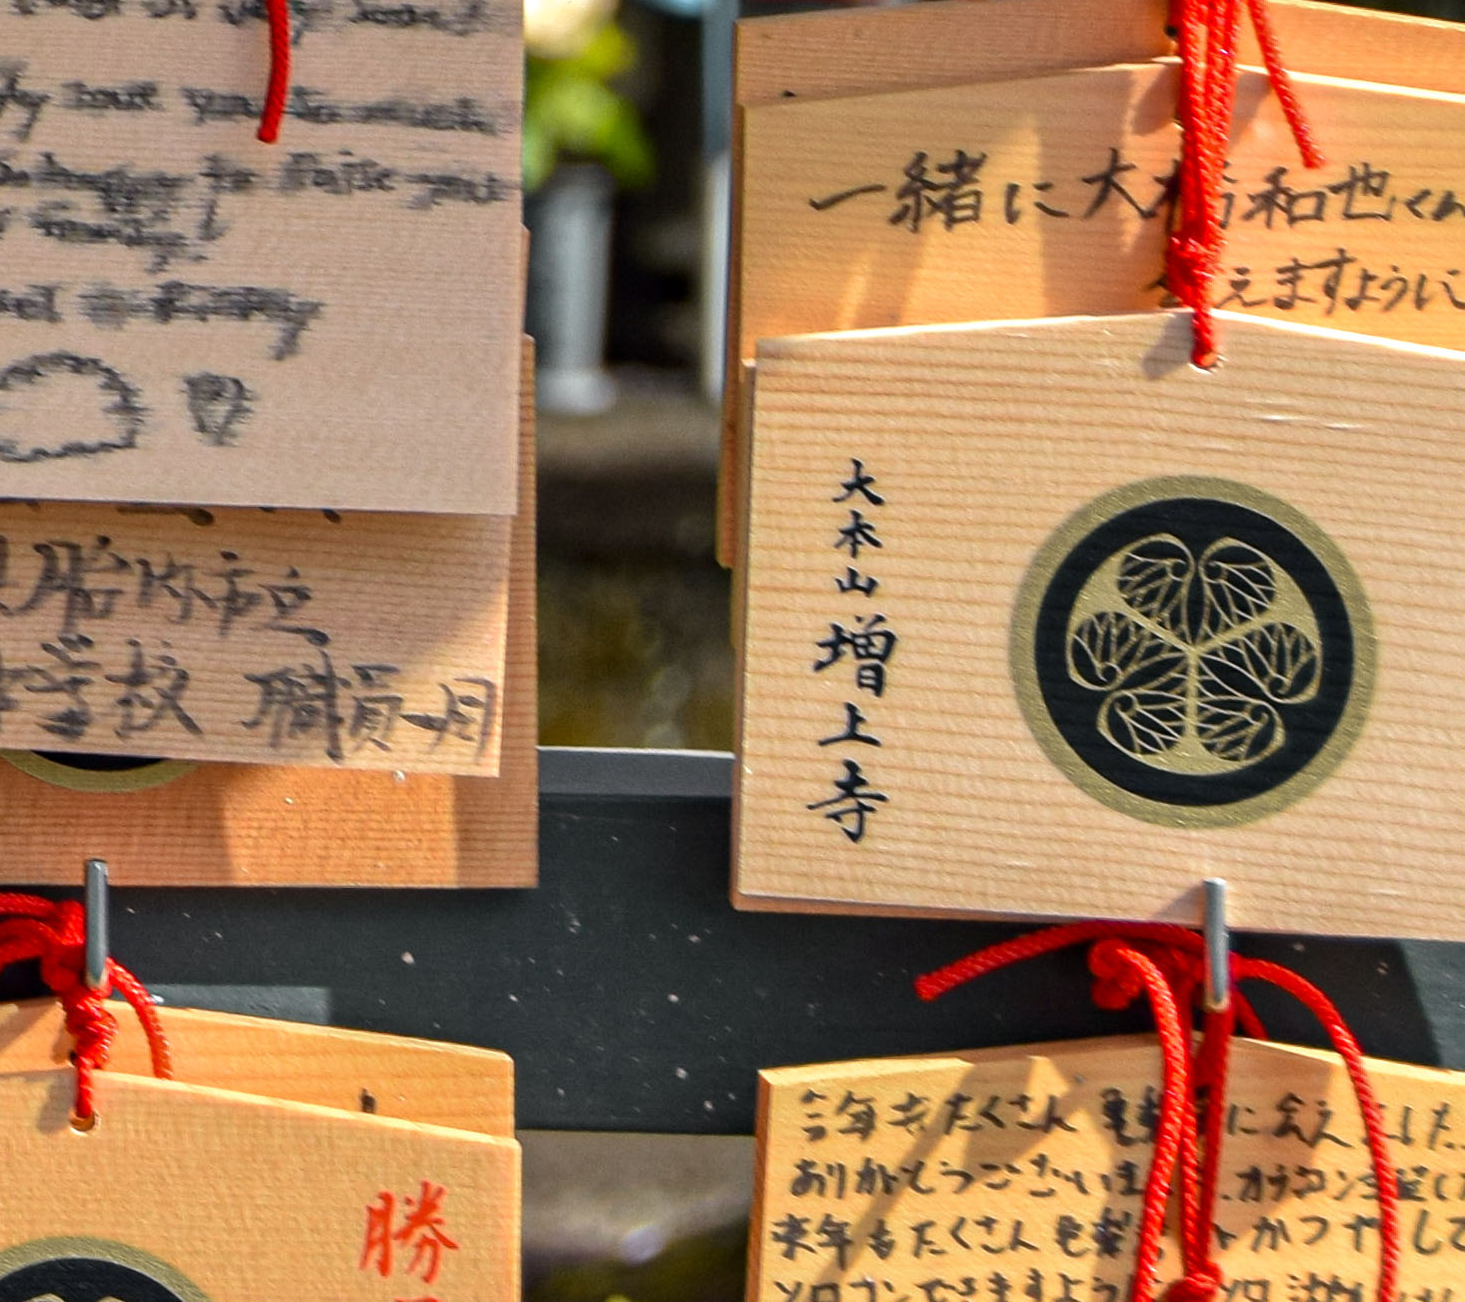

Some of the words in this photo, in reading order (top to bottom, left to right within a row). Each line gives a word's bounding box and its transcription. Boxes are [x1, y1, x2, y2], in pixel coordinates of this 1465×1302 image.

[1146, 247, 1465, 316] えますように
[807, 459, 898, 844] 大本山増上寺
[357, 1178, 461, 1284] 勝
